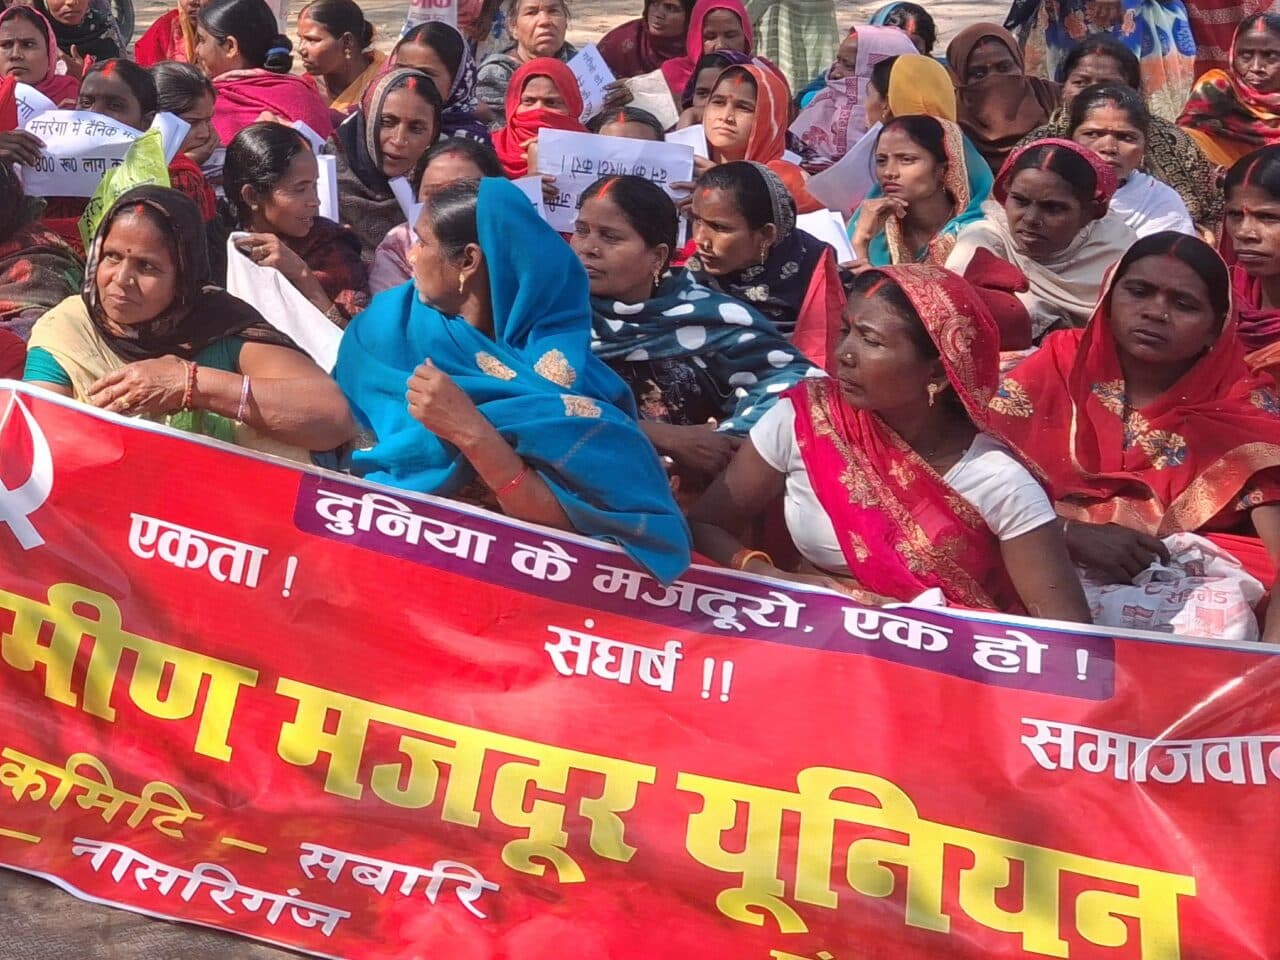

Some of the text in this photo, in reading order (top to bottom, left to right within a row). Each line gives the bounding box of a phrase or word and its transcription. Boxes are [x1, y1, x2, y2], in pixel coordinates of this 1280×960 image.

[30, 117, 67, 136] मनरेगा
[128, 511, 268, 588] एकता
[315, 488, 496, 564] दुनिया
[511, 540, 577, 582] के
[842, 606, 952, 652] एक
[973, 630, 1048, 675] हो
[544, 617, 682, 692] संघर्ष
[276, 676, 657, 884] मजदूर
[676, 766, 1197, 960] यूनियन
[70, 837, 352, 937] नासरिगंज
